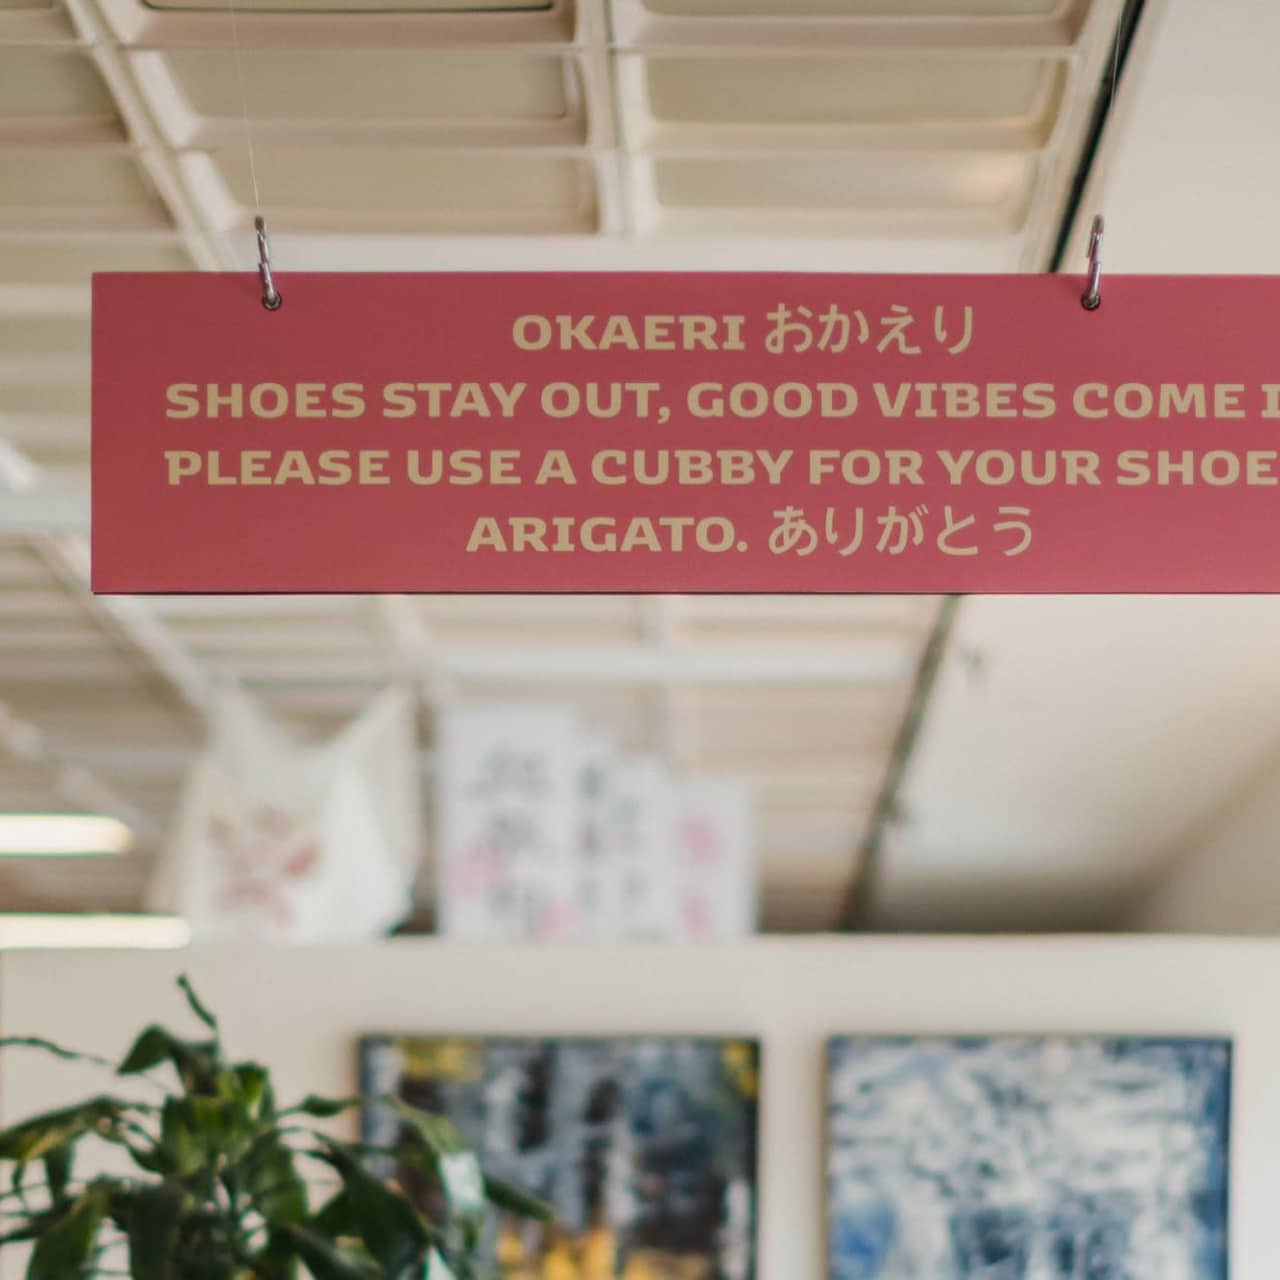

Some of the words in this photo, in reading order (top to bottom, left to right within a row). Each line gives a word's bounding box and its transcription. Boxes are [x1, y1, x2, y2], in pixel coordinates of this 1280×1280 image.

[512, 314, 746, 351] OKAERI
[764, 302, 974, 355] おかえり
[165, 381, 366, 419] SHOES
[382, 381, 528, 419] STAY
[540, 381, 671, 425] OUT,
[686, 381, 859, 419] GOOD
[872, 382, 1057, 419] VIBES
[1072, 382, 1246, 419] COME
[163, 449, 391, 486] PLEASE
[406, 448, 522, 486] USE
[534, 449, 577, 485] A
[591, 448, 794, 486] CUBBY
[809, 448, 925, 486] FOR
[935, 449, 1102, 486] YOUR
[465, 516, 748, 553] ARIGATO.
[768, 504, 1033, 557] ありがとう
